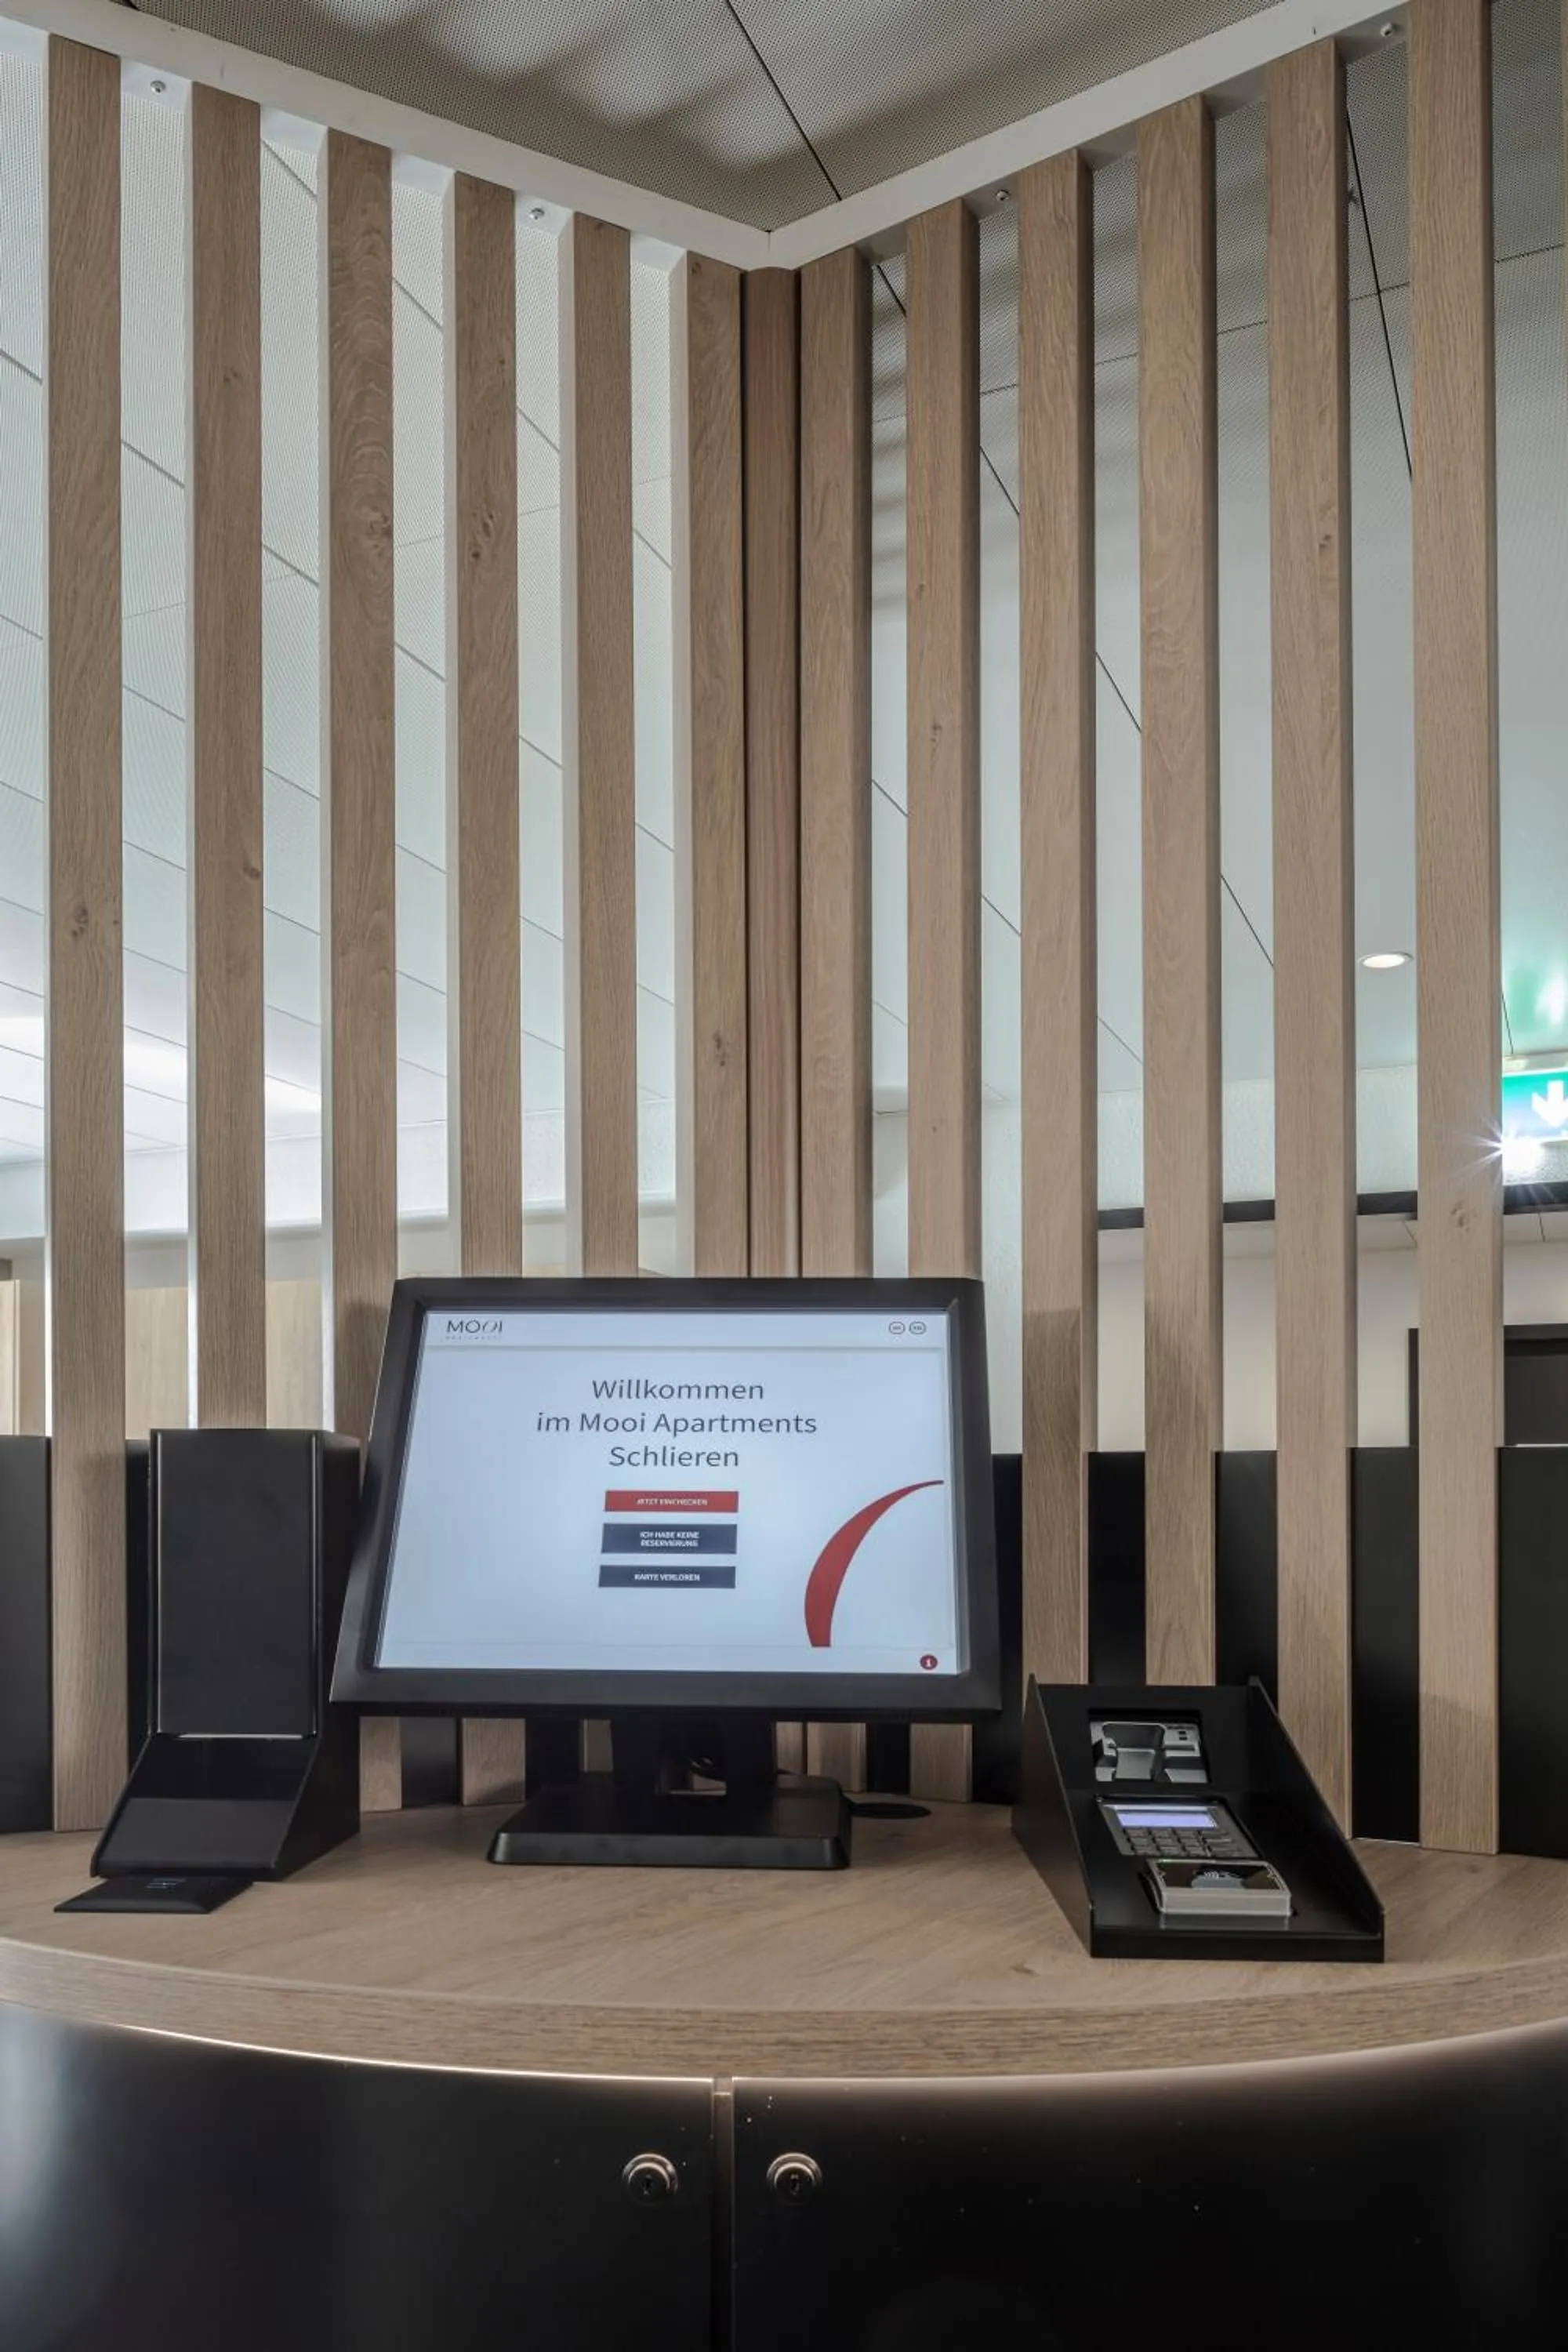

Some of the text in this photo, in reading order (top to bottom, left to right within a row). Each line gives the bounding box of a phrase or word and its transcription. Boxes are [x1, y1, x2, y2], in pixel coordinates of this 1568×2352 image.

[592, 1379, 764, 1401] Willkommen
[536, 1412, 817, 1437] im Mooi Apartments
[608, 1446, 739, 1468] Schlieren
